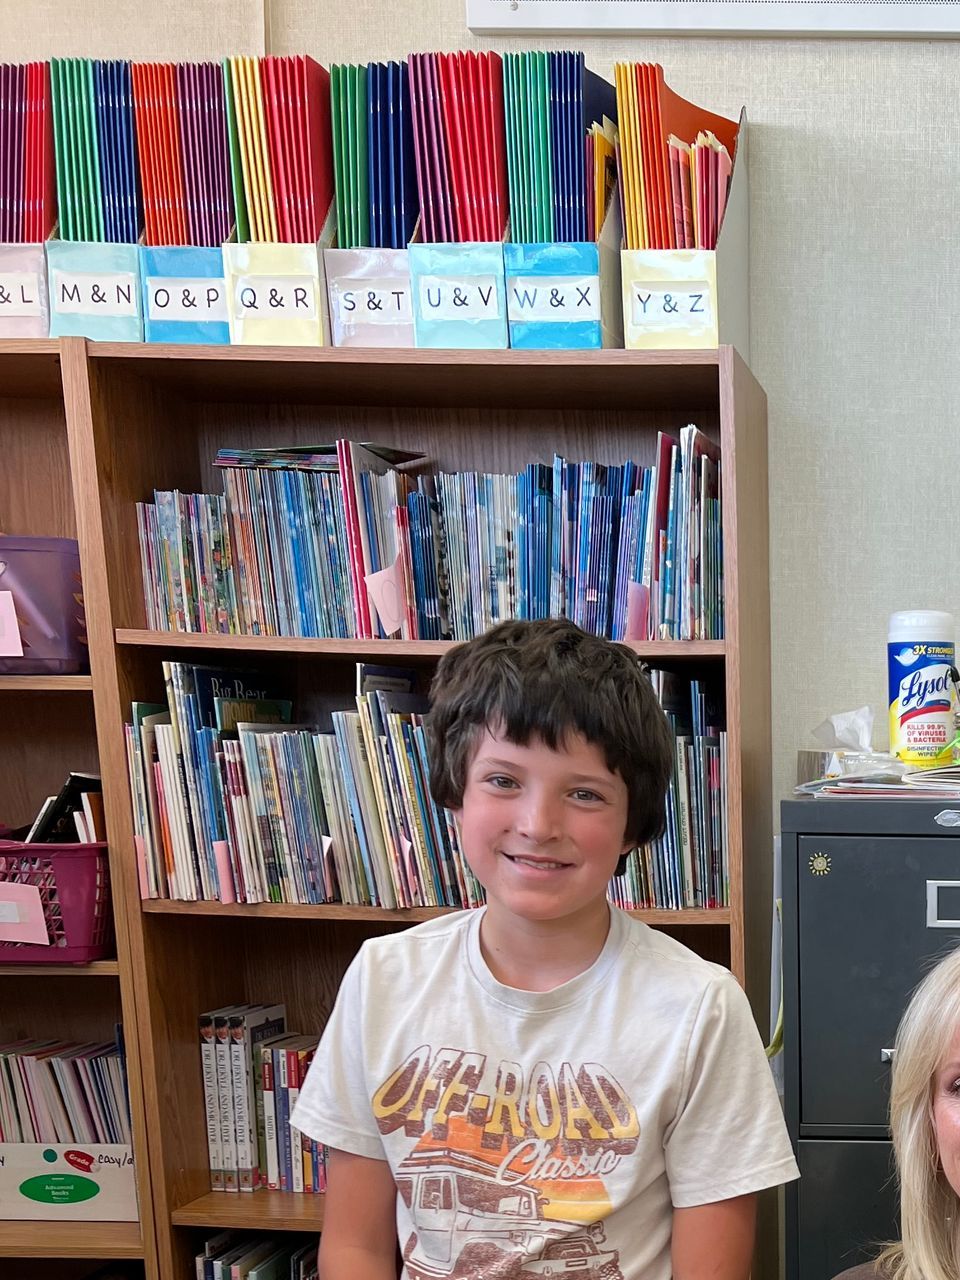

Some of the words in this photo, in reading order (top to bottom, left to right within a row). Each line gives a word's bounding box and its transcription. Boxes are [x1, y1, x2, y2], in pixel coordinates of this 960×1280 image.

[20, 284, 33, 304] L
[61, 283, 82, 303] M
[91, 284, 107, 302] &
[116, 284, 132, 304] N
[154, 288, 170, 308] O
[181, 289, 198, 308] &
[206, 288, 220, 308] P
[240, 287, 259, 310] Q
[269, 287, 285, 308] &
[294, 287, 310, 308] R
[343, 291, 357, 311] S
[366, 291, 383, 311] &
[391, 291, 405, 311] T
[426, 288, 442, 308] U
[452, 287, 469, 307] &
[478, 286, 493, 306] V
[513, 288, 538, 308] W
[550, 287, 565, 308] &
[576, 286, 592, 308] X
[636, 294, 651, 313] Y
[662, 294, 679, 313] &
[689, 294, 705, 313] Z
[912, 645, 927, 655] 3X
[901, 668, 951, 707] Lysol
[370, 1044, 641, 1152] OFF-ROAD
[495, 1138, 621, 1186] Classic
